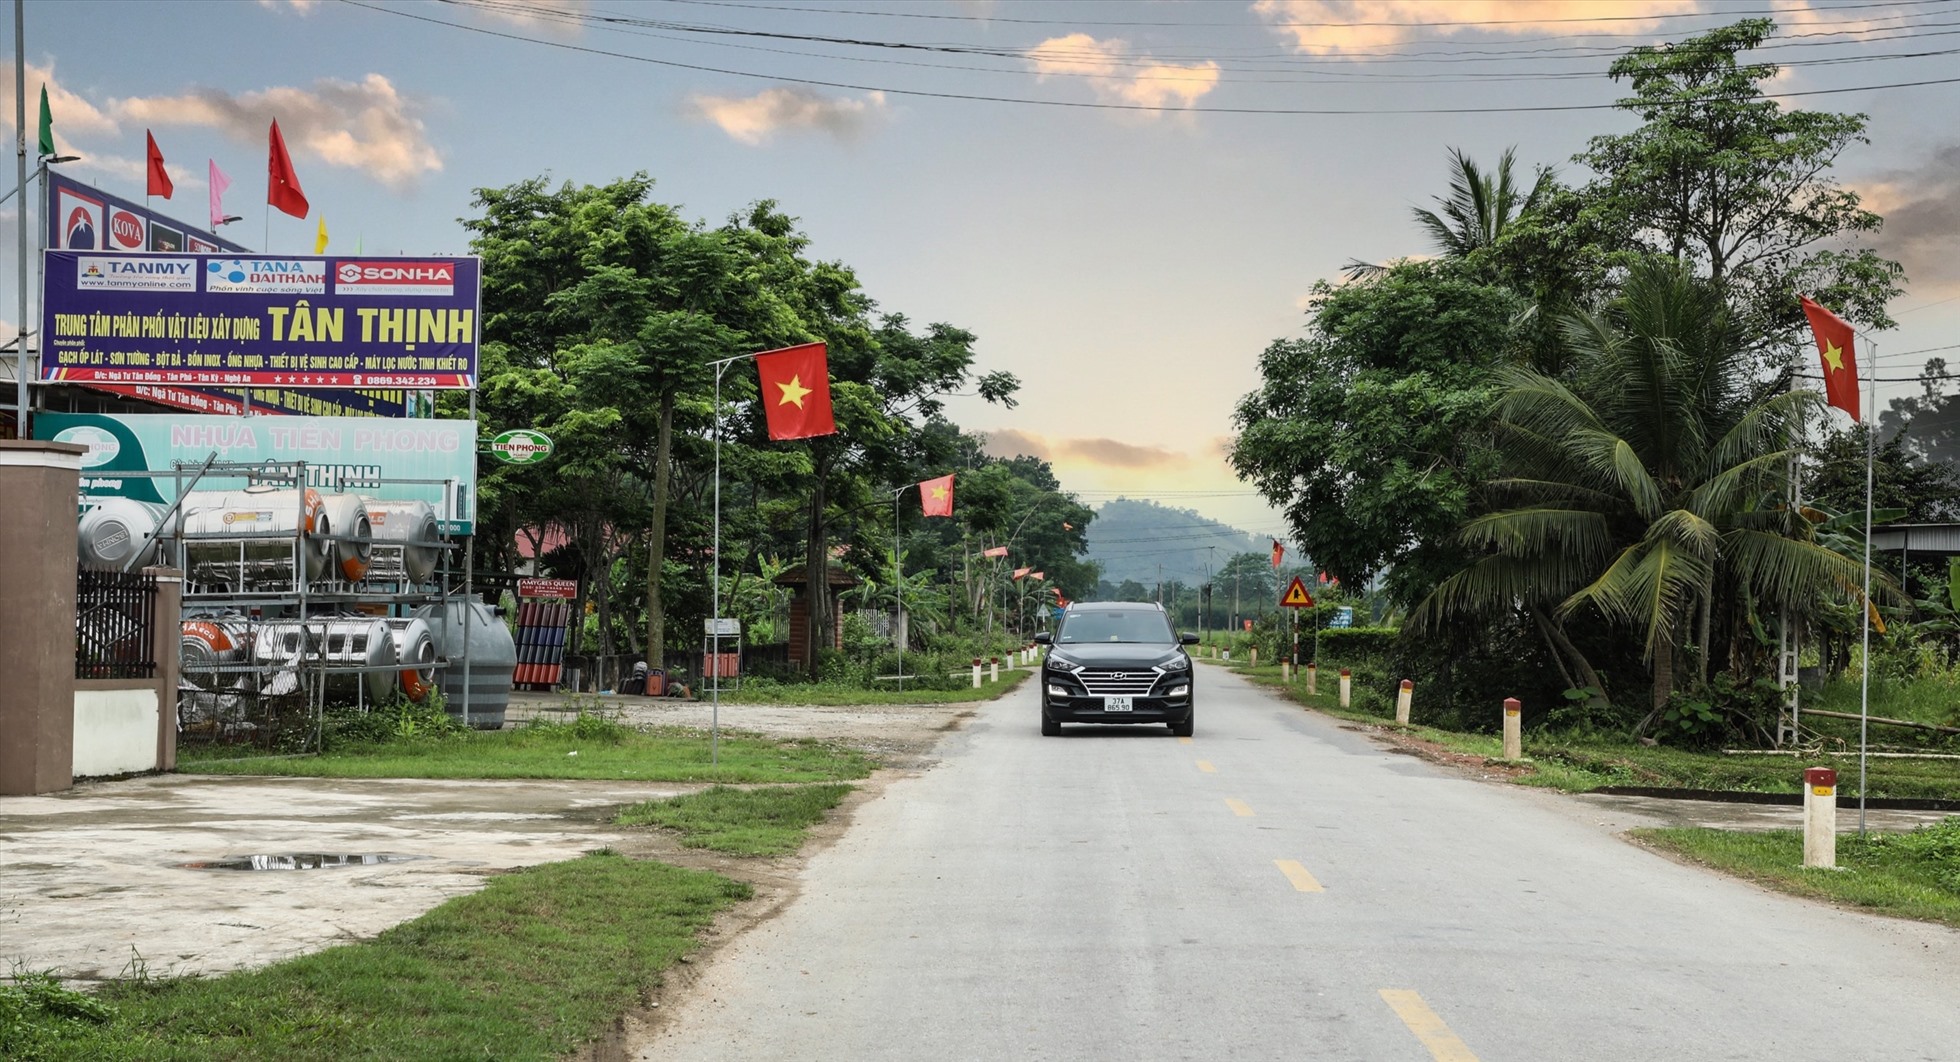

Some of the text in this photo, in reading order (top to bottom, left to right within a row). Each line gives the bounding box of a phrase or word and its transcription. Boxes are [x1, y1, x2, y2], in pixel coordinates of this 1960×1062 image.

[114, 217, 141, 241] KOVA
[107, 262, 190, 274] TANMY
[250, 262, 304, 272] TANA
[363, 268, 451, 280] SONHA
[81, 280, 191, 288] www.tanmyonline.com
[55, 308, 260, 345] TRUNG TÂM PHÂN PHỐI VẬT LIỆU XÂY DỰNG
[268, 300, 473, 351] TÂN THỊNH
[58, 351, 78, 366] GẠCH
[79, 347, 89, 364] ỐP
[90, 349, 104, 364] LÁT
[109, 351, 125, 365] SƠN
[126, 350, 150, 366] TƯỜNG
[156, 350, 170, 368] BỘT
[171, 349, 181, 366] BẢ
[204, 354, 221, 367] INOX
[227, 350, 243, 367] ỐNG
[244, 353, 263, 370] NHỰA
[270, 352, 289, 369] THIẾT
[290, 356, 298, 371] BỊ
[299, 353, 308, 371] VỆ
[309, 356, 327, 369] SINH
[328, 357, 342, 369] CAO
[344, 352, 359, 369] CẤP
[365, 354, 381, 370] MÁY
[382, 357, 396, 372] LỌC
[419, 357, 435, 370] TINH
[436, 354, 456, 370] KHIẾT
[171, 421, 257, 455] NHỰA
[354, 428, 460, 451] PHONG
[304, 463, 381, 493] THỊNH
